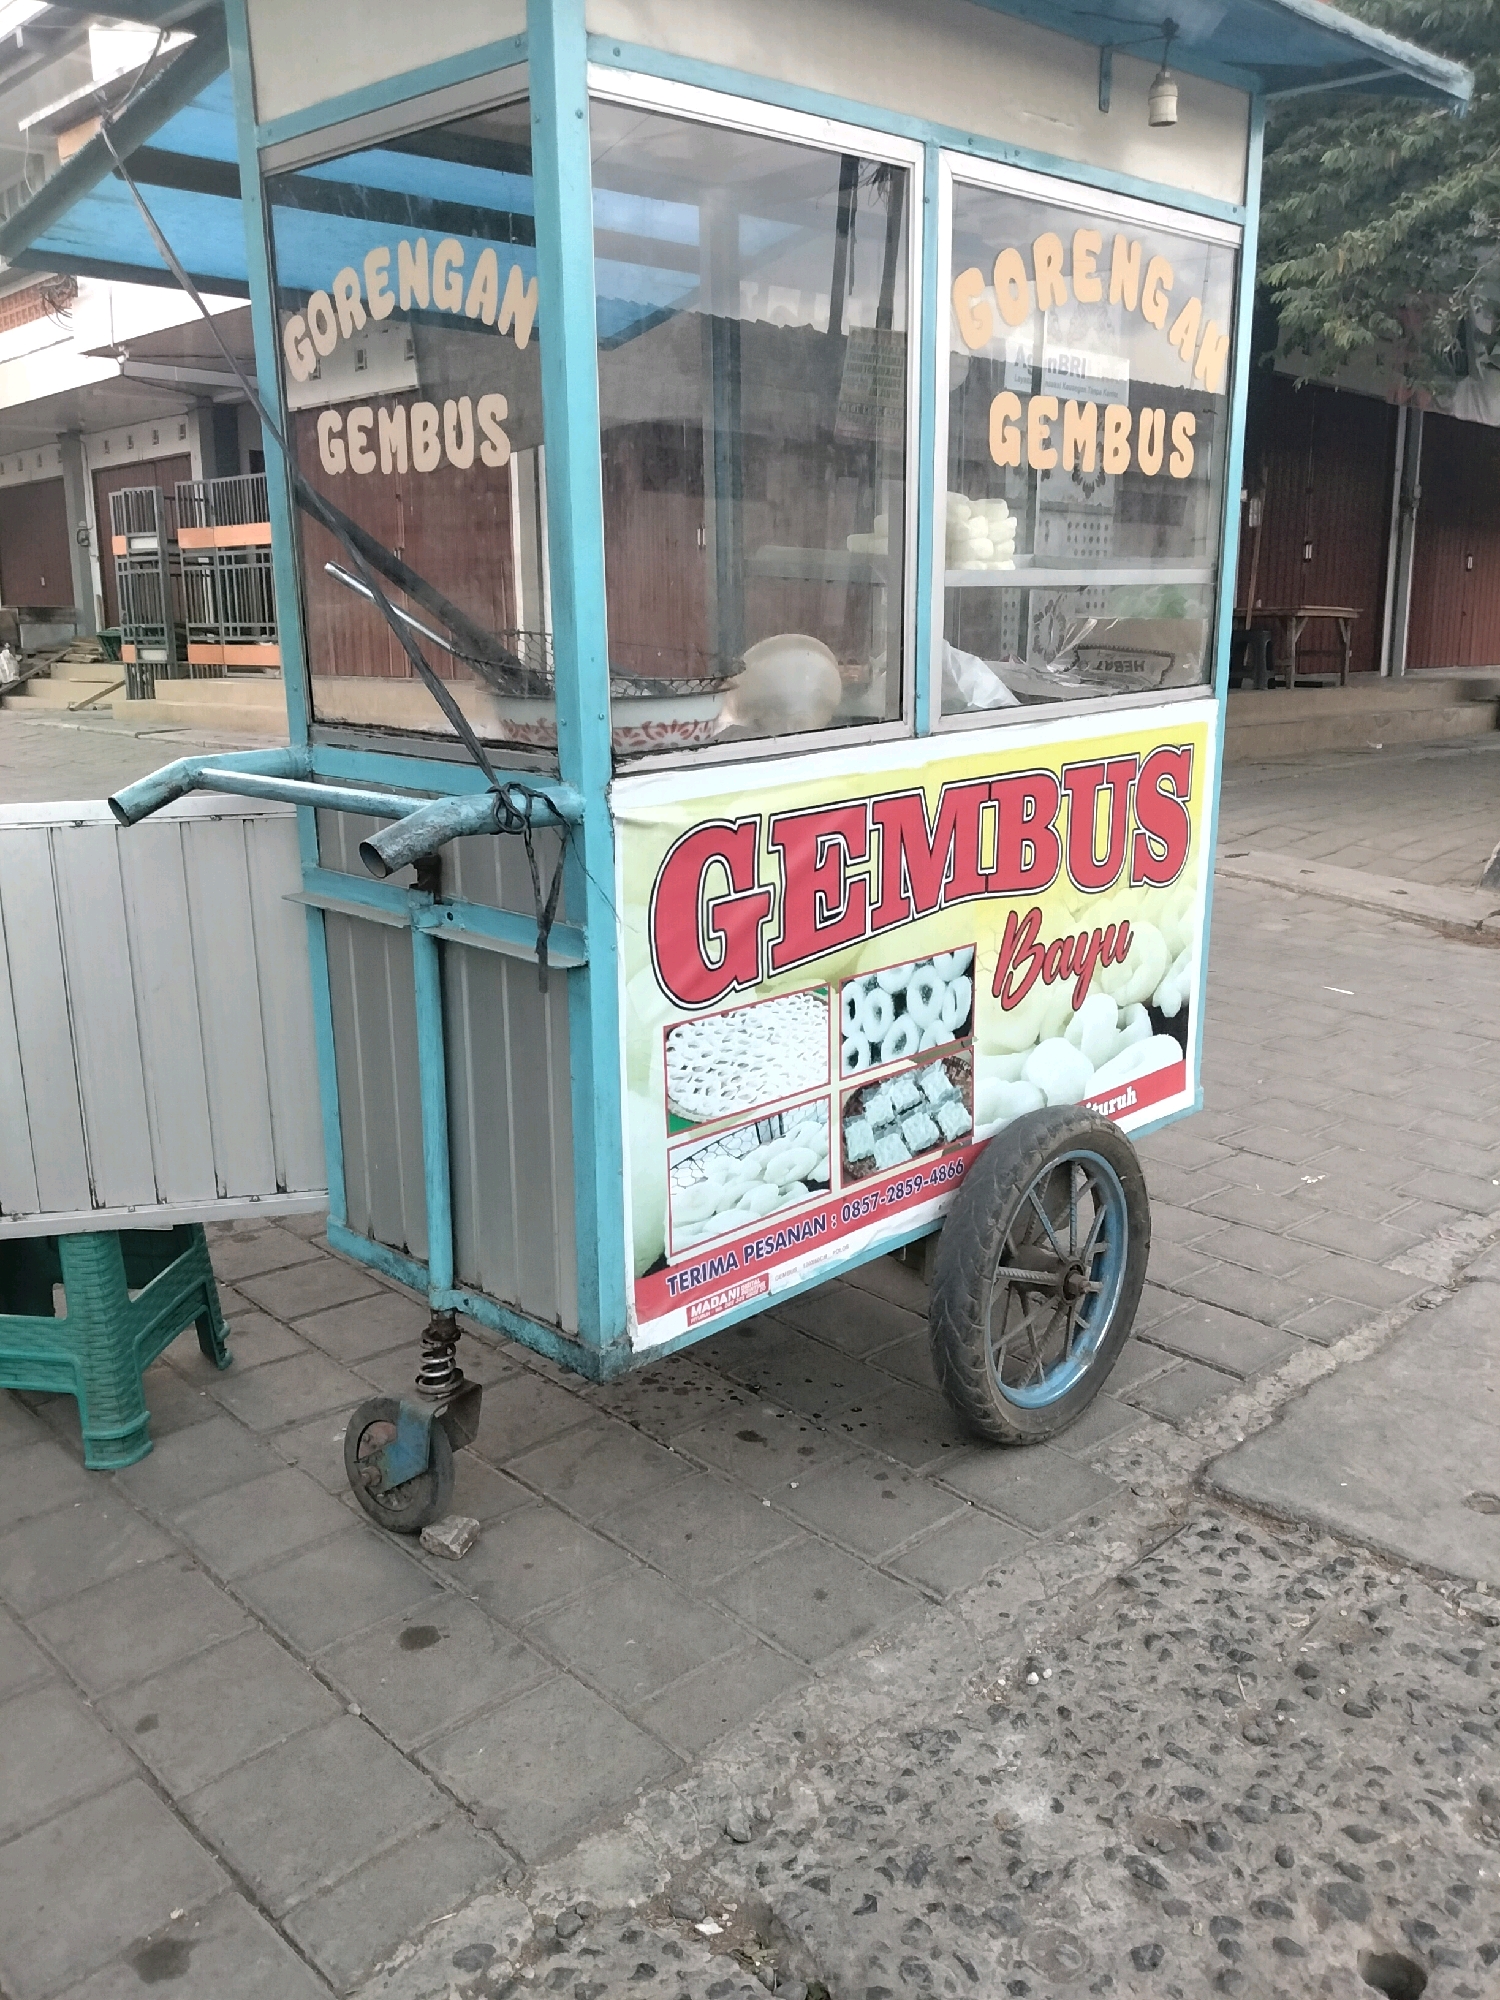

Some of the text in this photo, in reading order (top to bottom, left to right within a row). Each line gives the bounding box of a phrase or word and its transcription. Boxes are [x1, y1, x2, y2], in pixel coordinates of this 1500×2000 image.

[283, 237, 539, 382] GORENGAN
[953, 229, 1229, 393] GORENGAN
[317, 393, 511, 475] GEMBUS
[989, 392, 1196, 478] GEMBUS
[648, 743, 1194, 1010] GEMBUS
[992, 906, 1134, 1011] Bayu
[666, 1251, 739, 1297] TERIMA
[742, 1212, 828, 1265] PESANAN
[842, 1157, 965, 1223] 0857-2859-4866
[691, 1286, 741, 1318] MADANI
